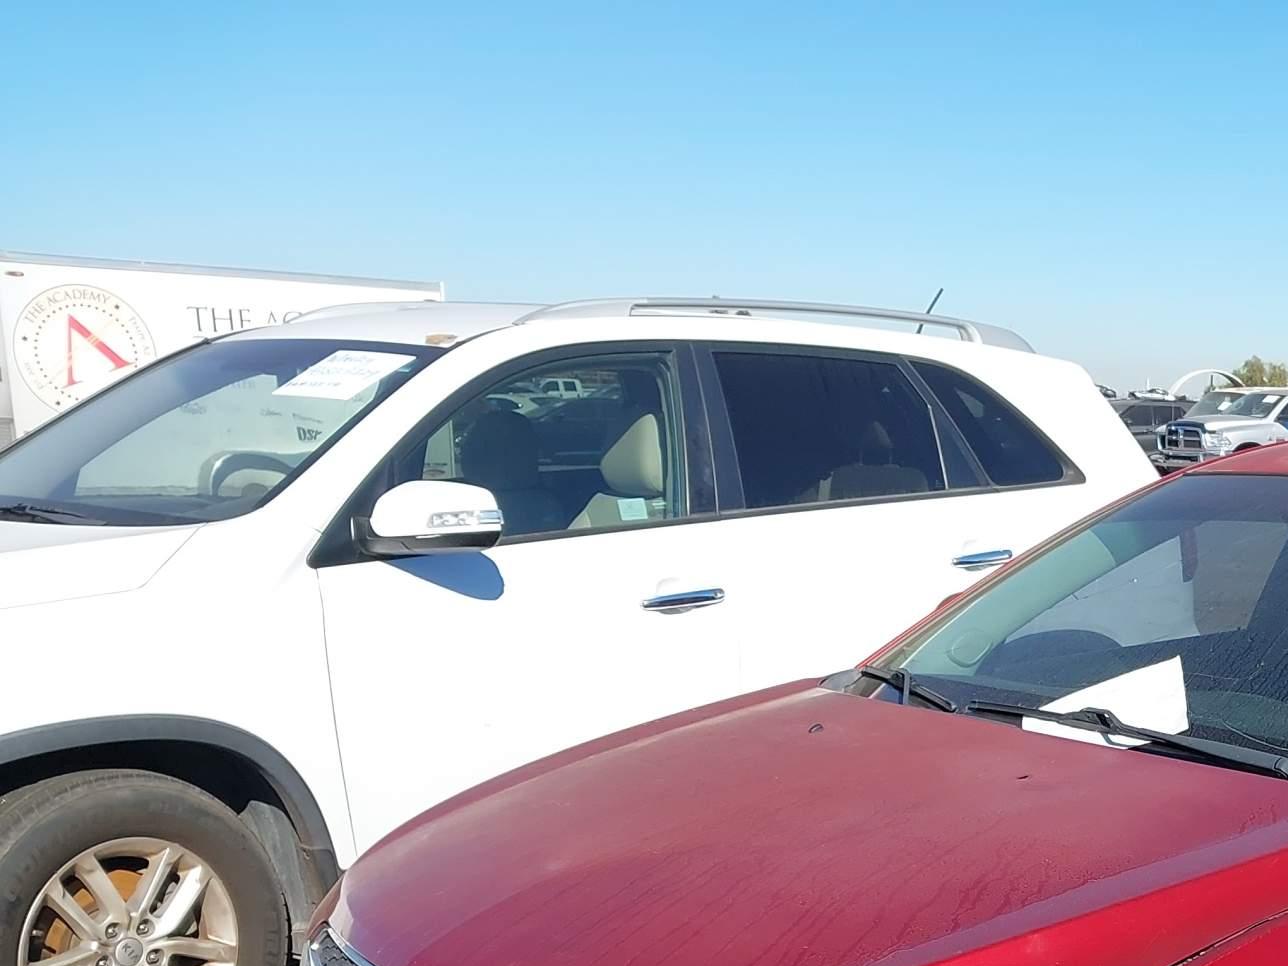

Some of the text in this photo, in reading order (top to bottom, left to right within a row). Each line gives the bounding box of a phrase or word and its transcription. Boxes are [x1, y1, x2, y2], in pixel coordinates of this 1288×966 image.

[24, 287, 111, 324] THE ACADEMY
[186, 305, 252, 333] THE
